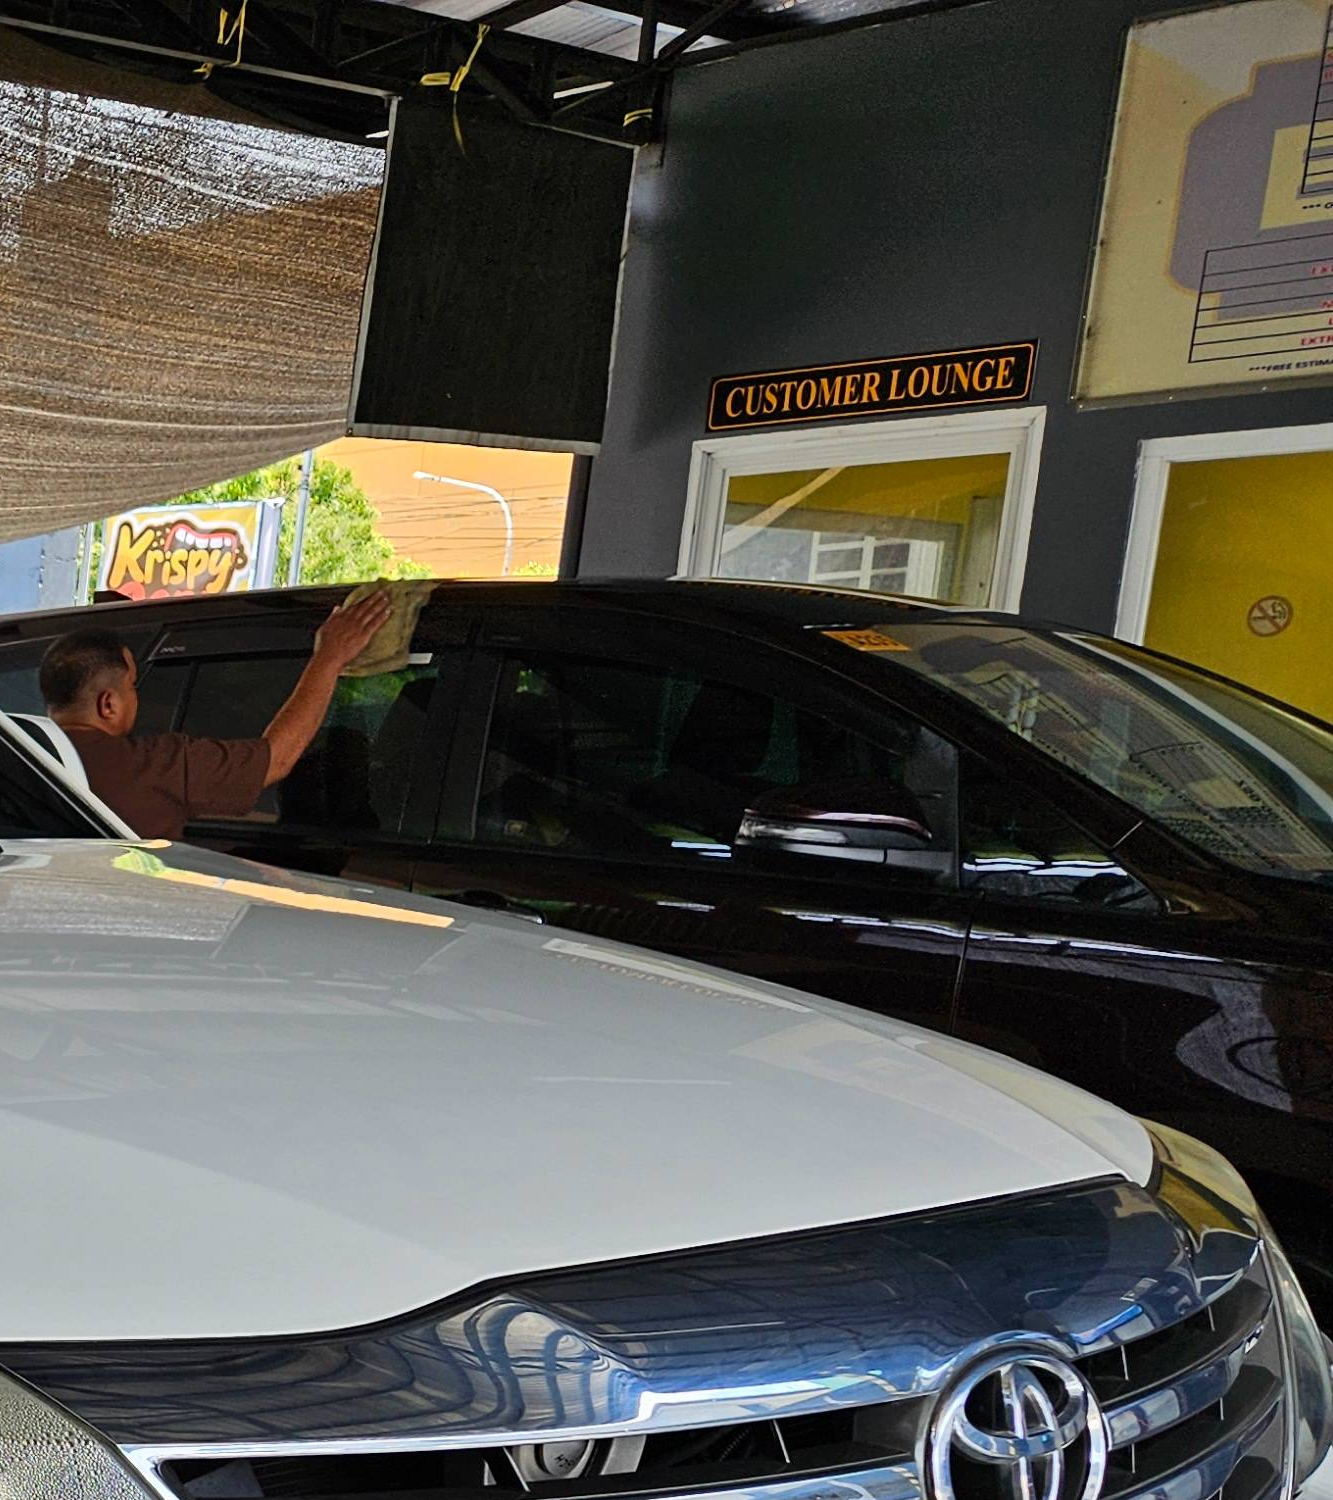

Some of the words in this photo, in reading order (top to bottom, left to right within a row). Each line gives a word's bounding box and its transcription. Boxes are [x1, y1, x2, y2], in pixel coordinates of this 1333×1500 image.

[725, 371, 881, 419] CUSTOMER
[888, 356, 1017, 401] LOUNGE
[109, 523, 232, 594] Krispy
